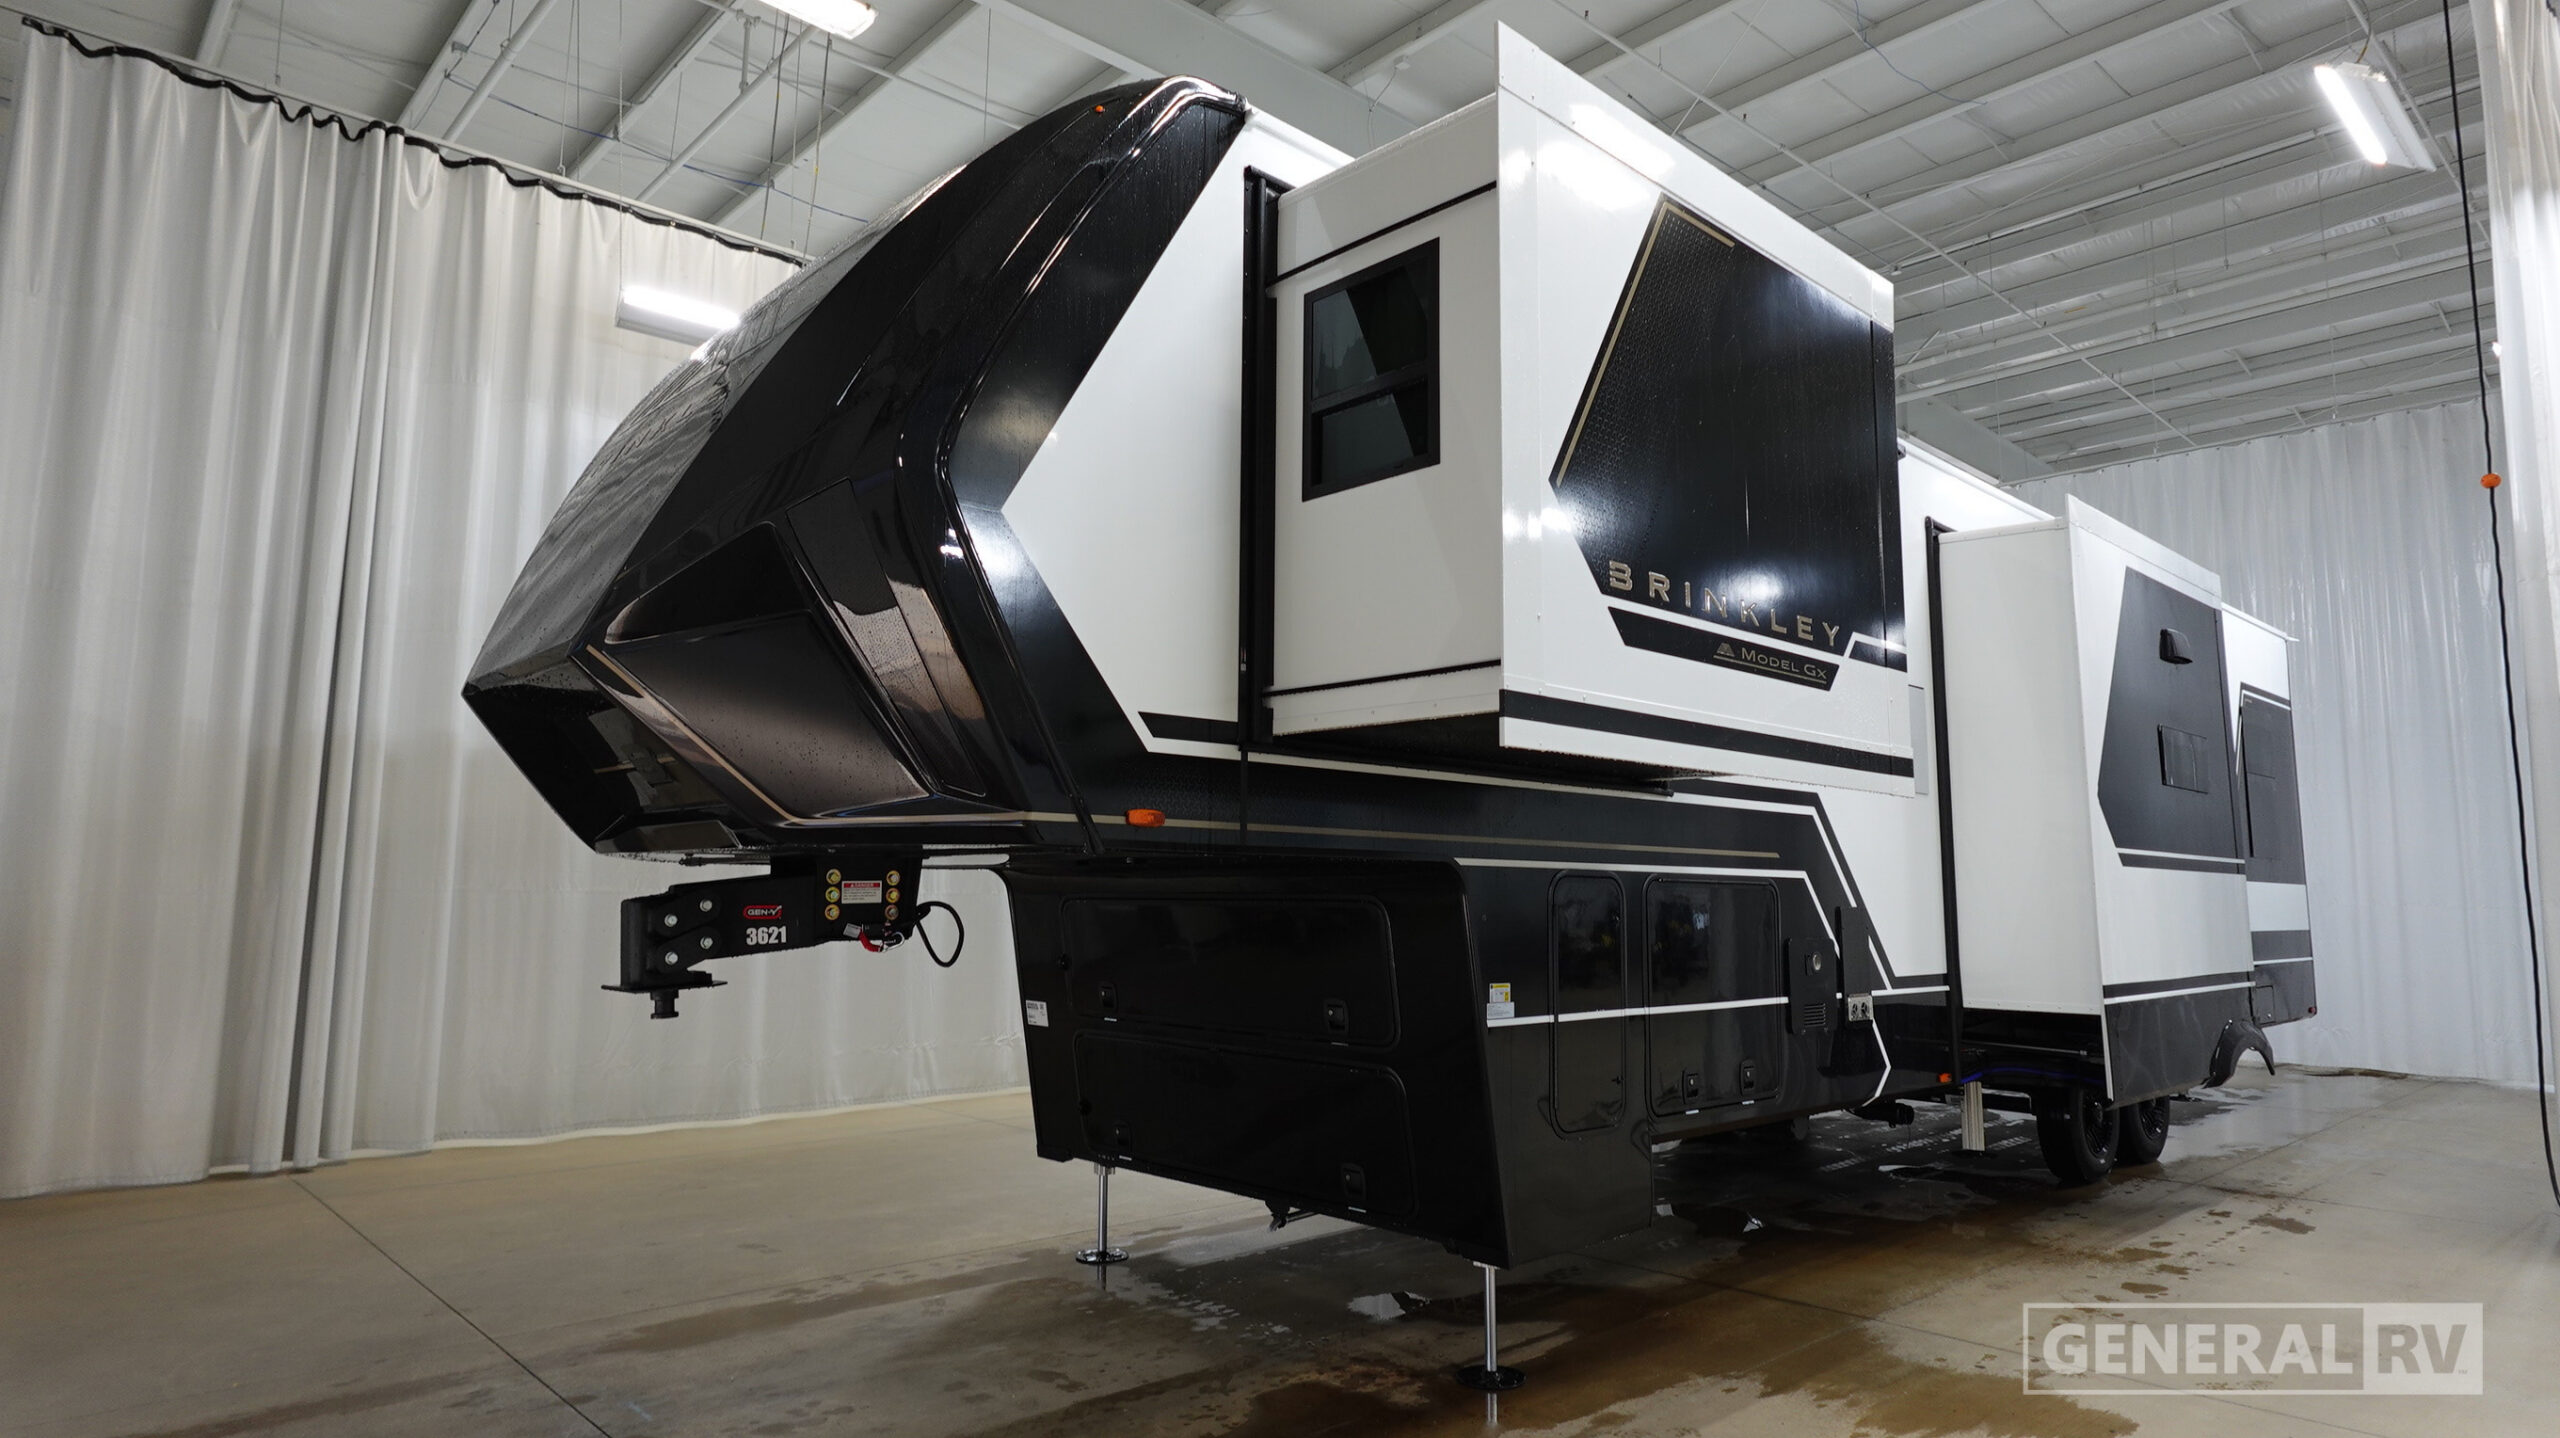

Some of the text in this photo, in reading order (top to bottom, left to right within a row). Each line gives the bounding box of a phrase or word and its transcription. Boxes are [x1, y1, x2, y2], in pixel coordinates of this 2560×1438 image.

[1609, 560, 1840, 647] BRINKLEY
[747, 905, 782, 916] GEN-Y
[746, 925, 787, 946] 3621
